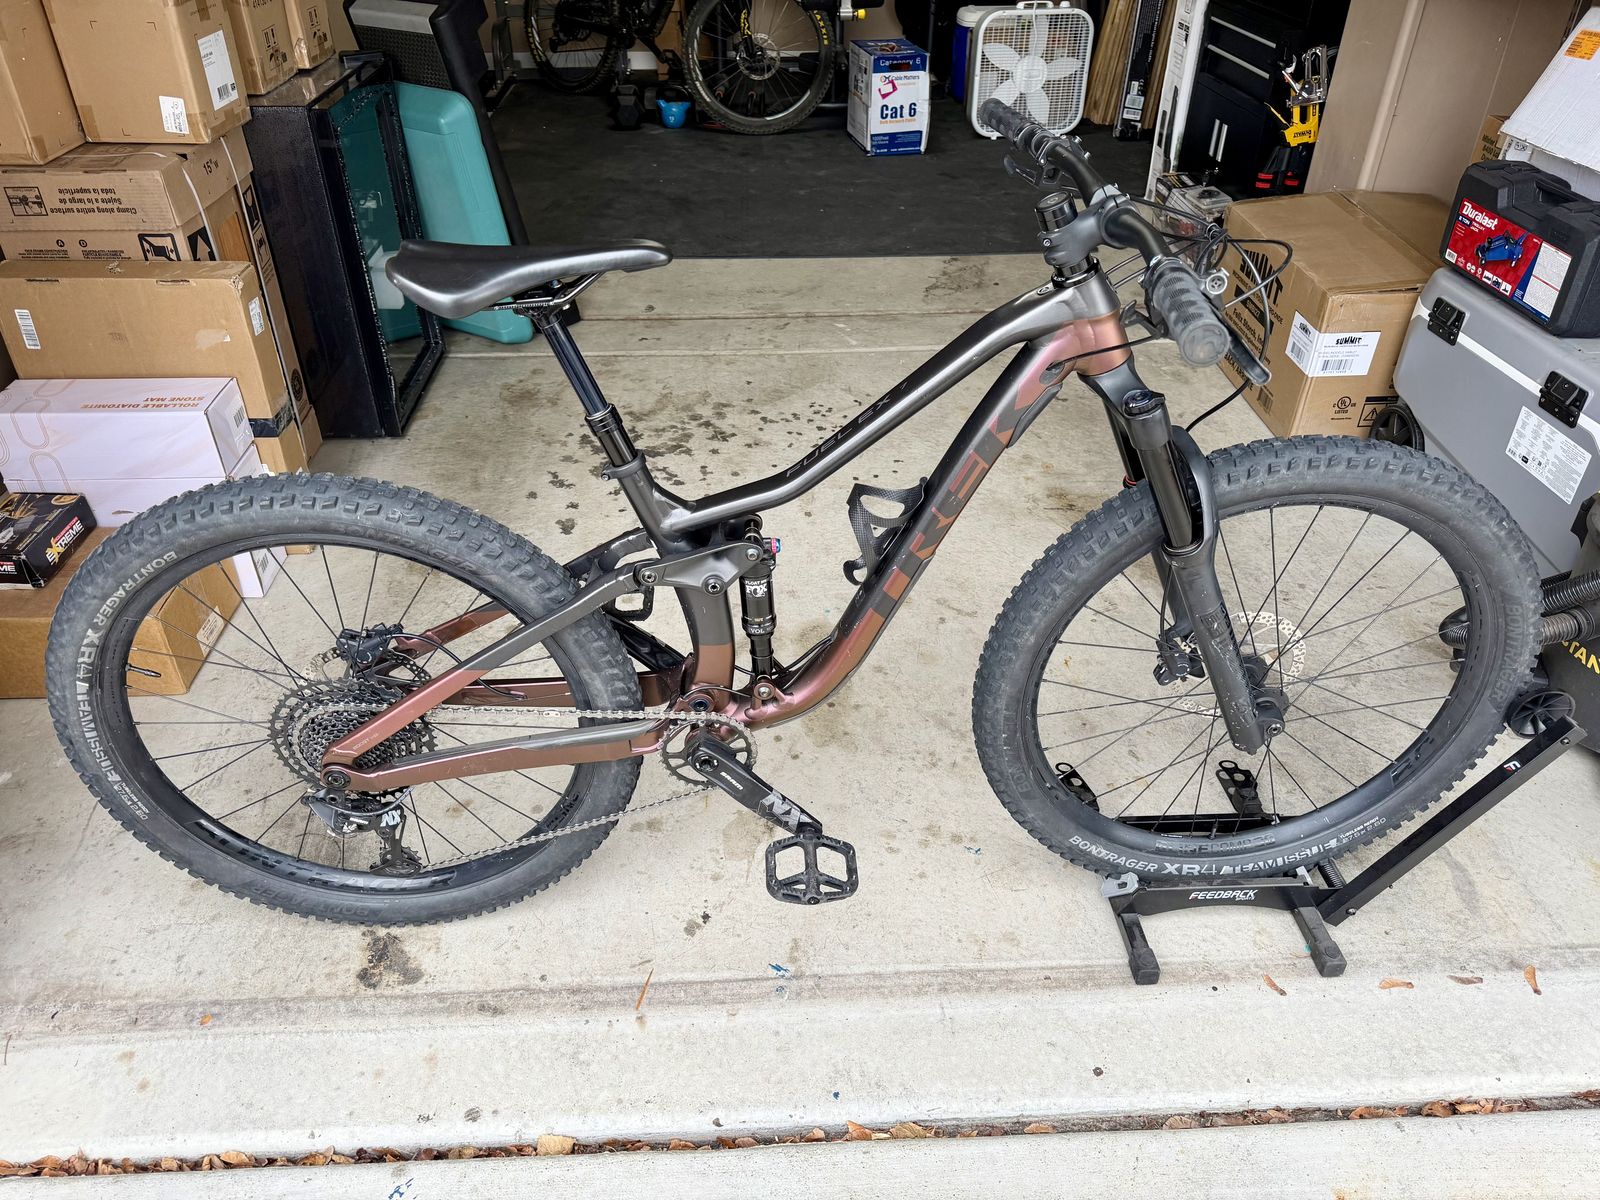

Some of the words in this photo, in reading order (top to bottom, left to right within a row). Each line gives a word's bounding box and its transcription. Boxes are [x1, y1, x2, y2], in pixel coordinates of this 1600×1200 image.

[915, 57, 921, 65] 6
[880, 104, 904, 120] Cat
[908, 102, 917, 118] 6
[58, 187, 91, 195] superficie
[69, 197, 85, 205] largo
[101, 197, 122, 205] Sujete
[50, 206, 74, 214] surface
[96, 206, 115, 214] along
[116, 207, 137, 215] Clamp
[1463, 201, 1499, 230] Duralast
[1232, 307, 1244, 321] Felix
[1241, 318, 1260, 341] Storch,
[1335, 336, 1363, 345] SUMMIT
[787, 428, 853, 477] FUEL
[858, 395, 890, 424] EX
[46, 520, 84, 566] EXTREME
[93, 551, 178, 626] BONTRAGER
[746, 584, 768, 598] FOX
[76, 628, 105, 679] XR4
[1561, 640, 1600, 675] TAN
[380, 809, 402, 828] NX
[1068, 835, 1159, 873] BONTRAGER
[1161, 862, 1217, 875] XR4
[1188, 889, 1258, 900] FEEDBACK
